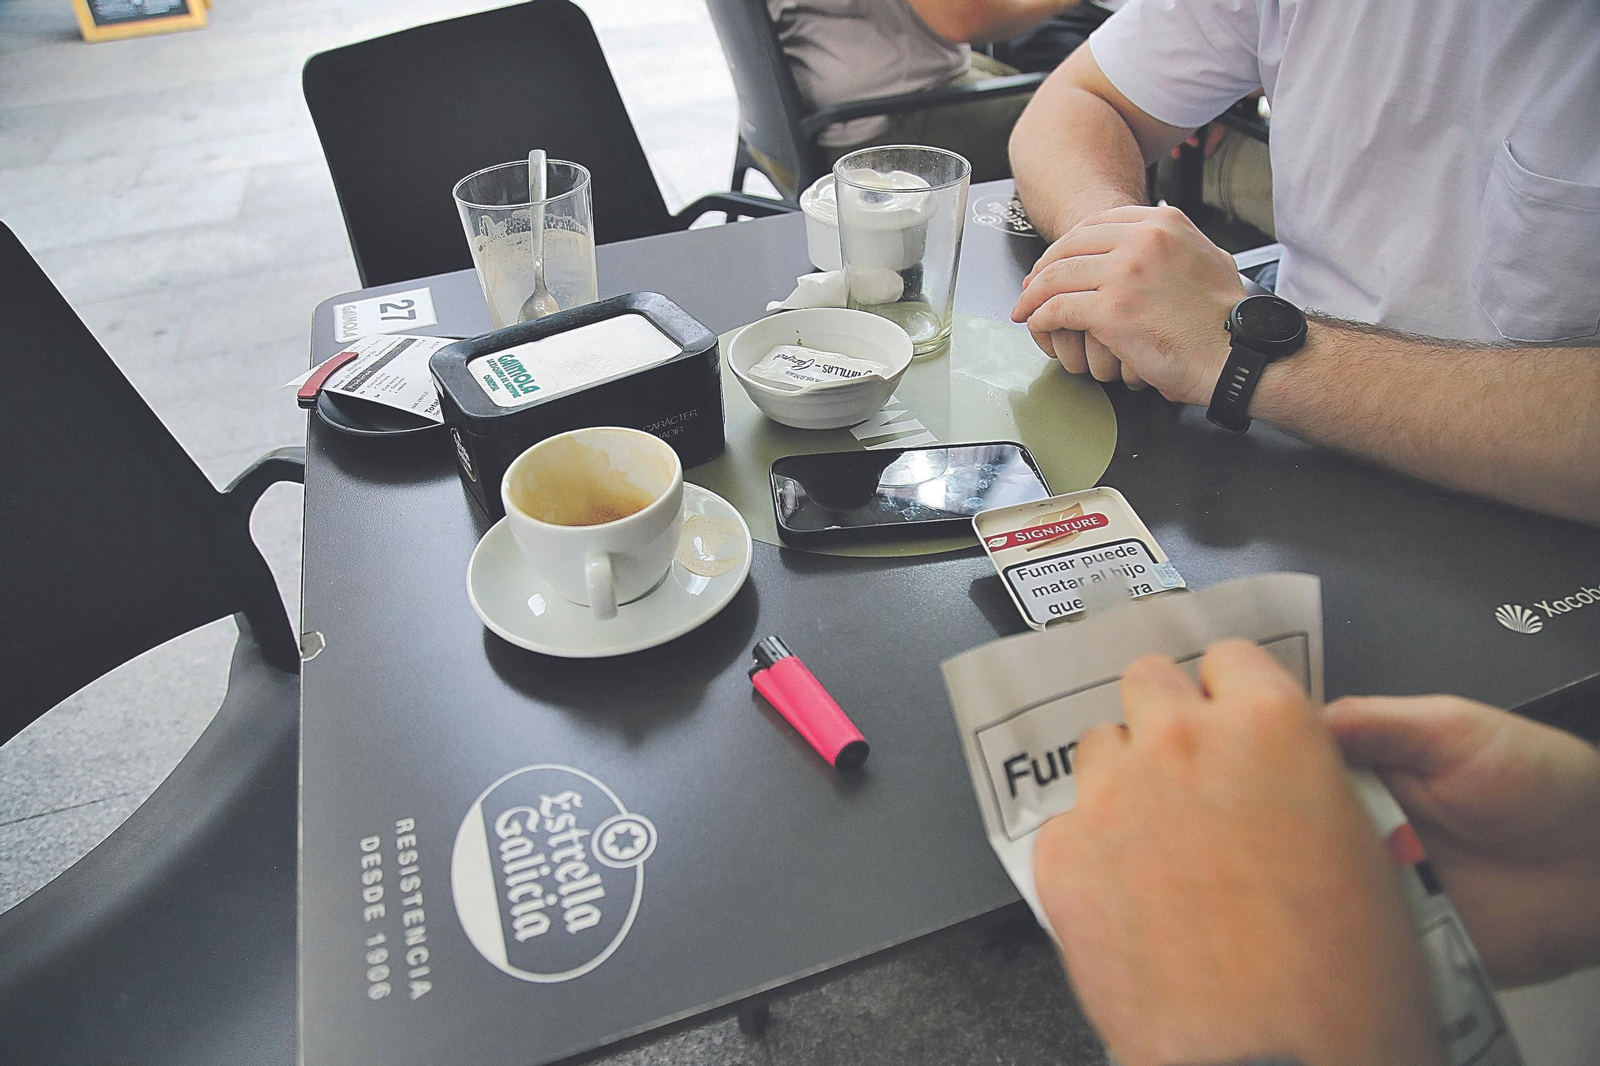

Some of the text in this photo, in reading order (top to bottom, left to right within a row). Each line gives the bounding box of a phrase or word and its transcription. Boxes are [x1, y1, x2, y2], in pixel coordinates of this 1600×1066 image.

[379, 299, 417, 321] 27
[498, 354, 541, 394] GAIMOLA
[1014, 516, 1101, 542] SIGNATURE
[1016, 545, 1138, 582] Fumar puede
[1032, 575, 1084, 598] matar
[1092, 569, 1105, 584] al
[1113, 563, 1146, 579] hijo
[1048, 598, 1084, 615] que
[1533, 585, 1600, 618] Xacob
[494, 805, 558, 943] Galicia
[540, 790, 605, 935] Estrella
[359, 834, 392, 1001] DESDE 1906
[395, 816, 433, 1000] RESISTENCIA
